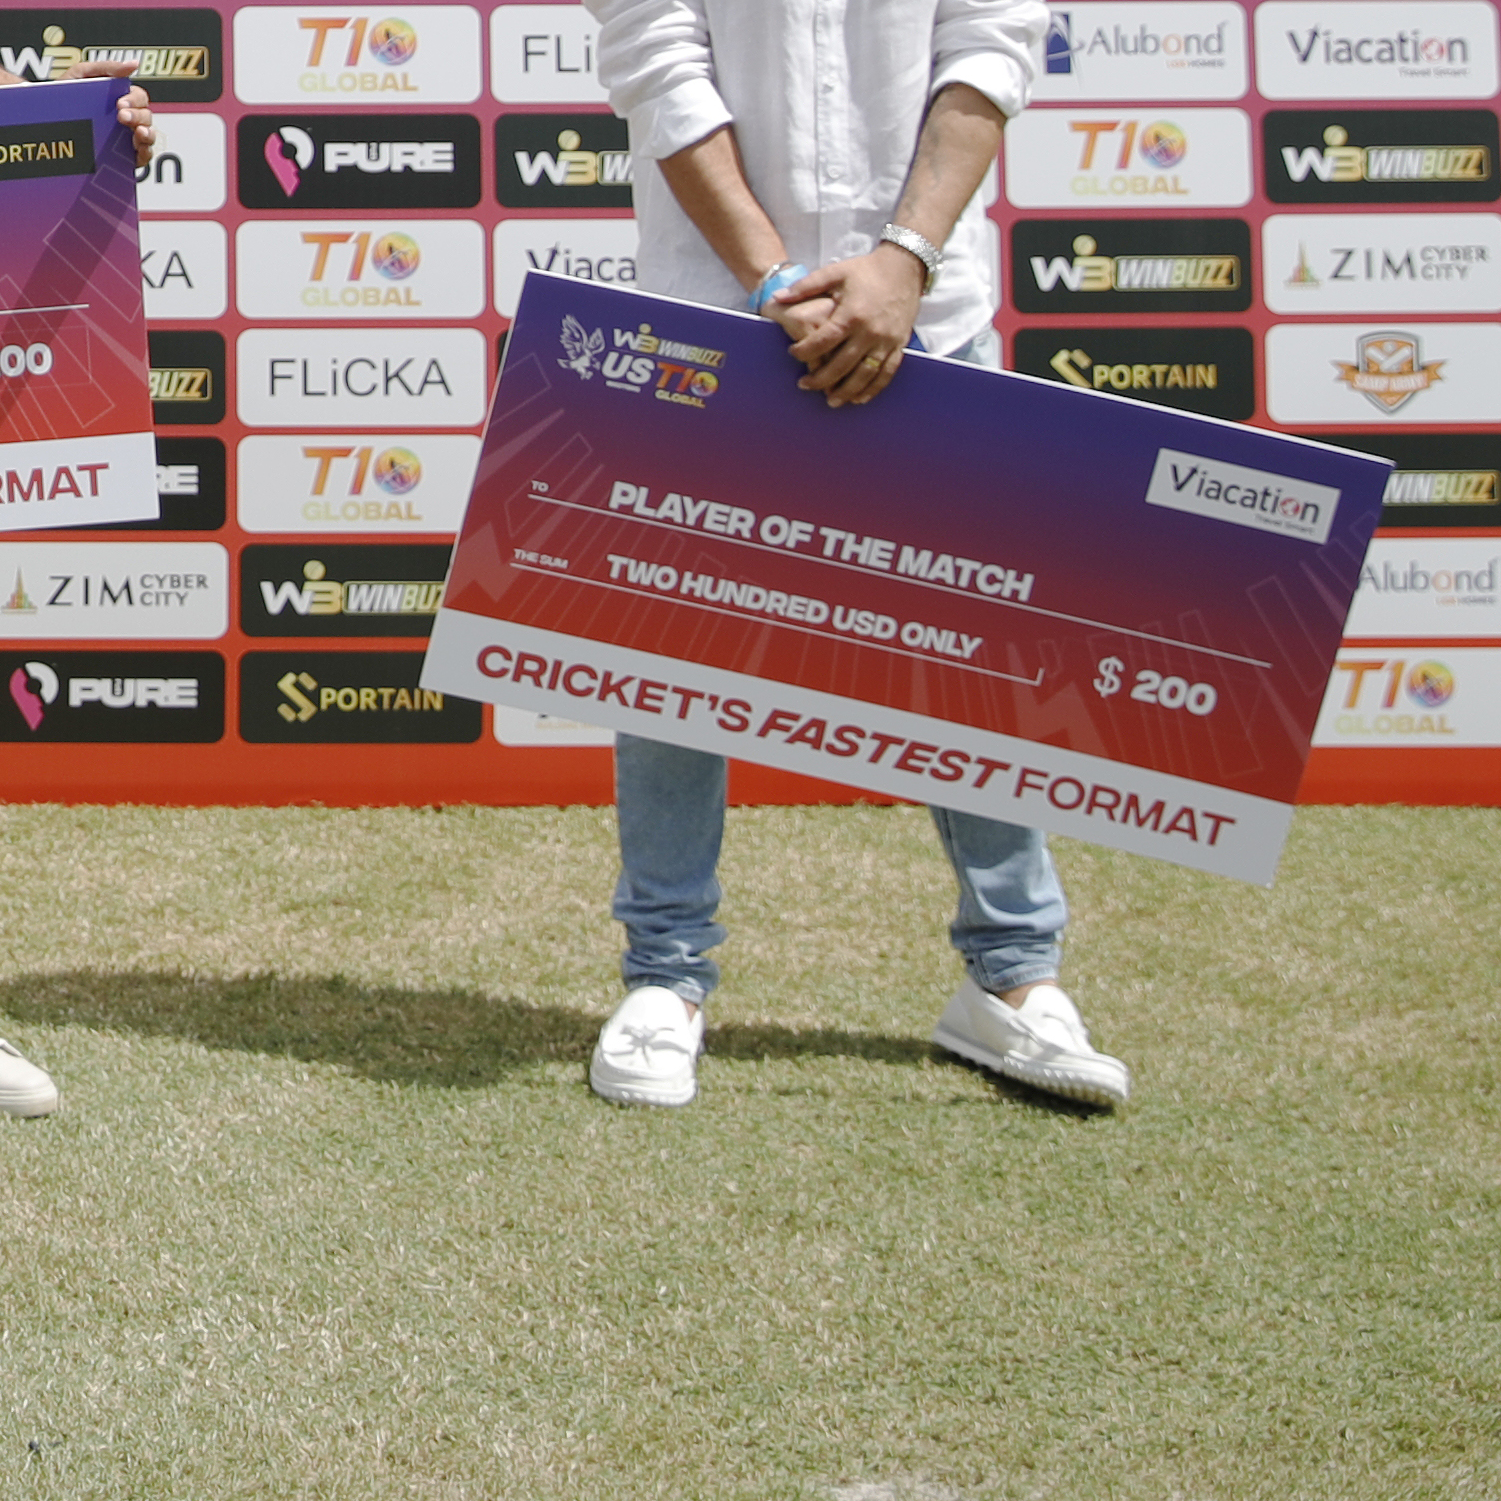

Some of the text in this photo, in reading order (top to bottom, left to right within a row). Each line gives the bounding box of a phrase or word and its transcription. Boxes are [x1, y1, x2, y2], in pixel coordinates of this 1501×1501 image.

[1288, 28, 1468, 64] Viacation
[325, 141, 454, 172] PURE
[302, 232, 421, 281] T10
[301, 286, 421, 307] GLOBAL
[271, 359, 450, 397] FLiCKA
[602, 351, 655, 384] US
[655, 389, 706, 408] GLOBAL
[531, 480, 549, 492] TO
[1171, 464, 1320, 523] Viacation
[609, 480, 1035, 601] PLAYER OF THE MATCH
[514, 548, 568, 570] THE SUM
[48, 575, 207, 607] ZIM CYBER
[140, 590, 187, 607] CITY
[607, 554, 983, 660] TWO HUNDRED USD ONLY
[1093, 656, 1218, 716] $ 200
[477, 645, 1235, 847] CRICKET'S FASTEST FORMAT
